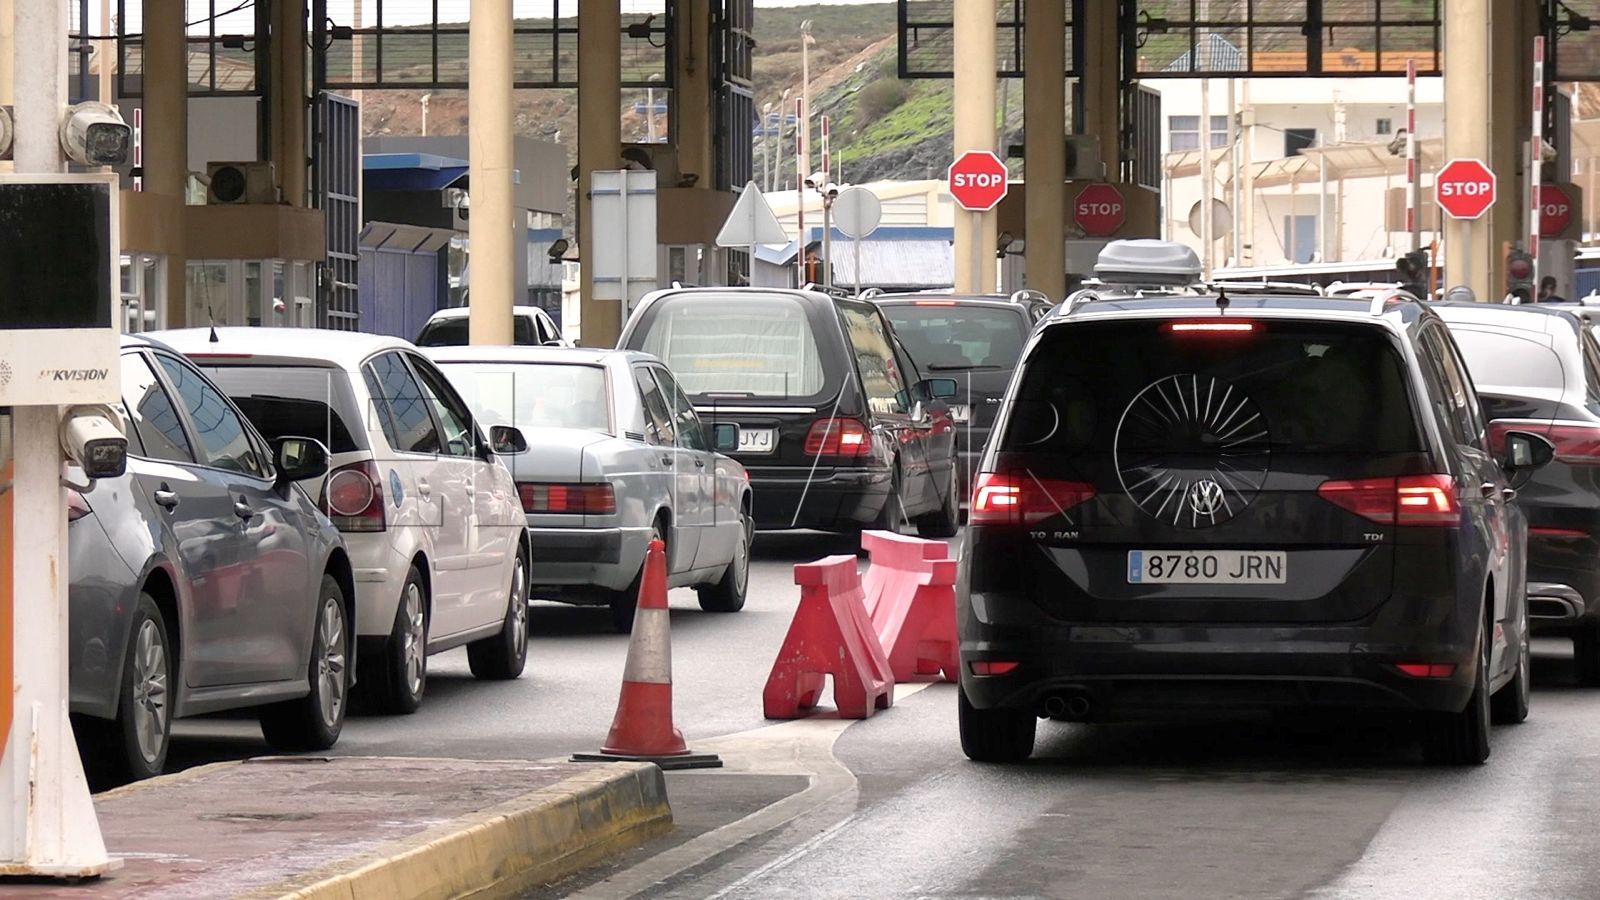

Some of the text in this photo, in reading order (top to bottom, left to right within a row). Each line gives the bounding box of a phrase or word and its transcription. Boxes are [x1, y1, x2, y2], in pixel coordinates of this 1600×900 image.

[954, 173, 1002, 187] STOP
[1441, 182, 1490, 196] STOP
[1079, 203, 1121, 215] STOP
[1539, 204, 1568, 216] TOP
[740, 432, 768, 446] JYJ
[1363, 533, 1384, 541] TDI
[1148, 555, 1218, 579] 8780
[1229, 555, 1281, 579] JRN
